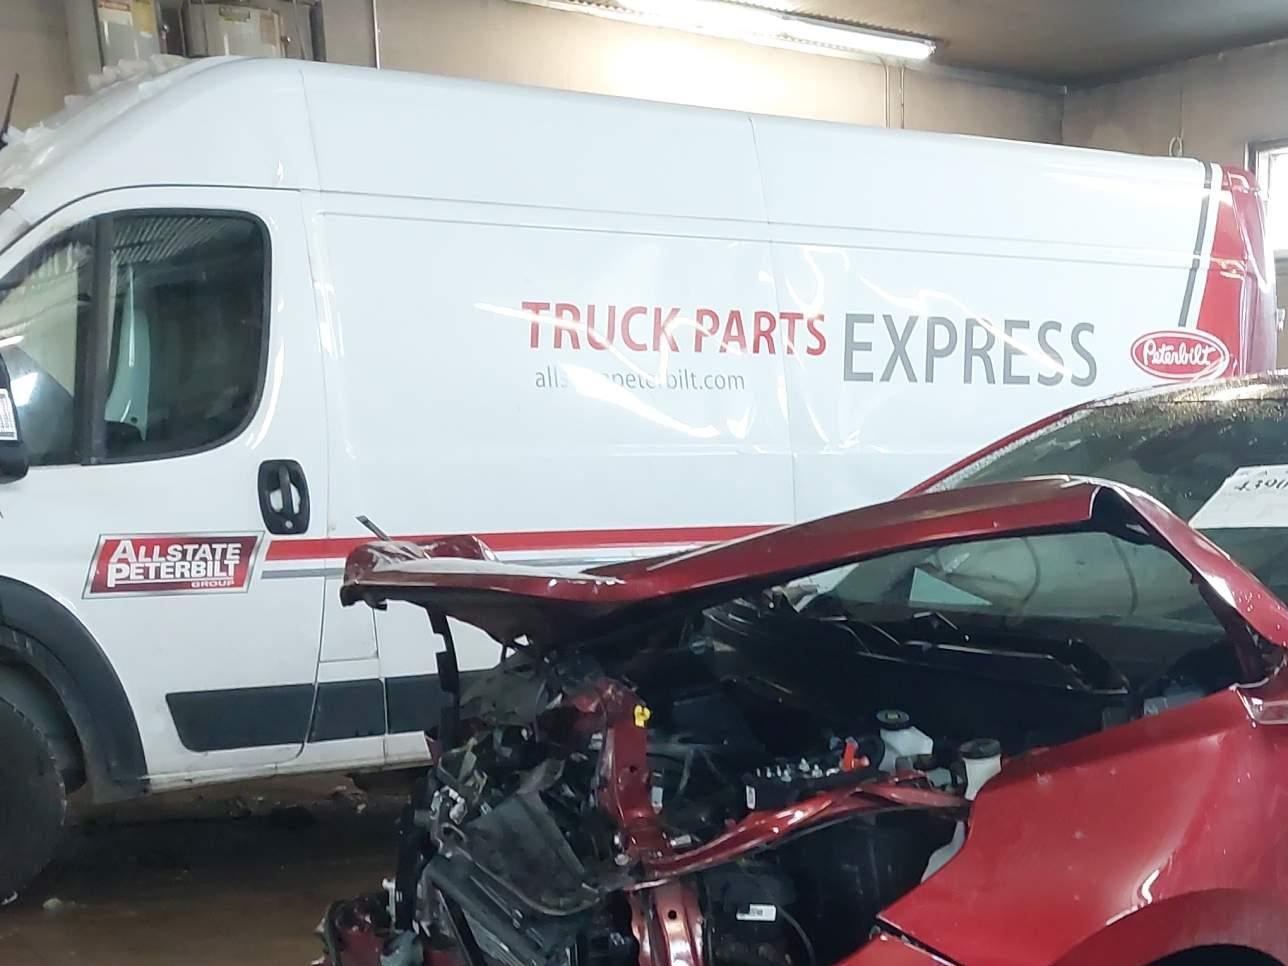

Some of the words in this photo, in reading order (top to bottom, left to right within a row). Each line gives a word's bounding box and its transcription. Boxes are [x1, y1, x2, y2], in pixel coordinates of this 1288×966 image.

[521, 300, 681, 352] TRUCK
[694, 308, 827, 356] PARTS
[843, 312, 1098, 388] EXPRESS
[1142, 338, 1217, 367] Peterbilt
[109, 539, 242, 562] ALLSTATE
[107, 560, 240, 588] PETERBILT
[191, 579, 235, 588] GROUP
